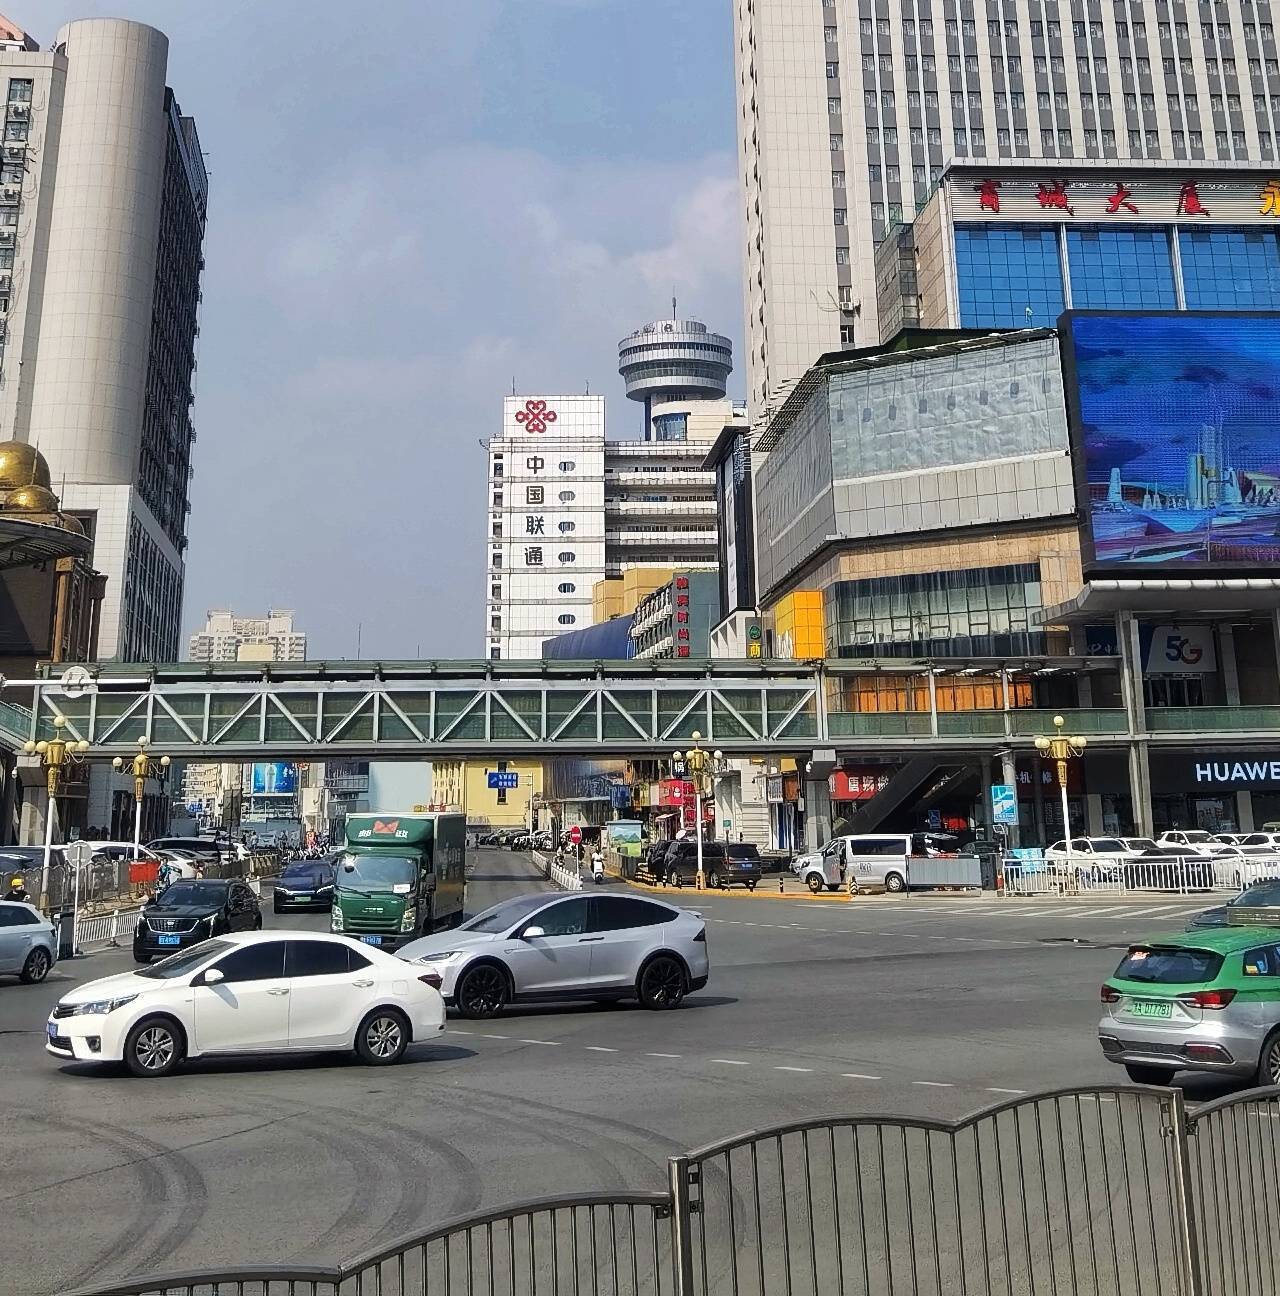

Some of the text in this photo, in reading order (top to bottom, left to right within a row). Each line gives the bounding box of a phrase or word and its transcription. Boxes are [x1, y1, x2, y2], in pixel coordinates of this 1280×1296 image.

[523, 455, 545, 567] 中国联通
[1165, 635, 1203, 664] 5G
